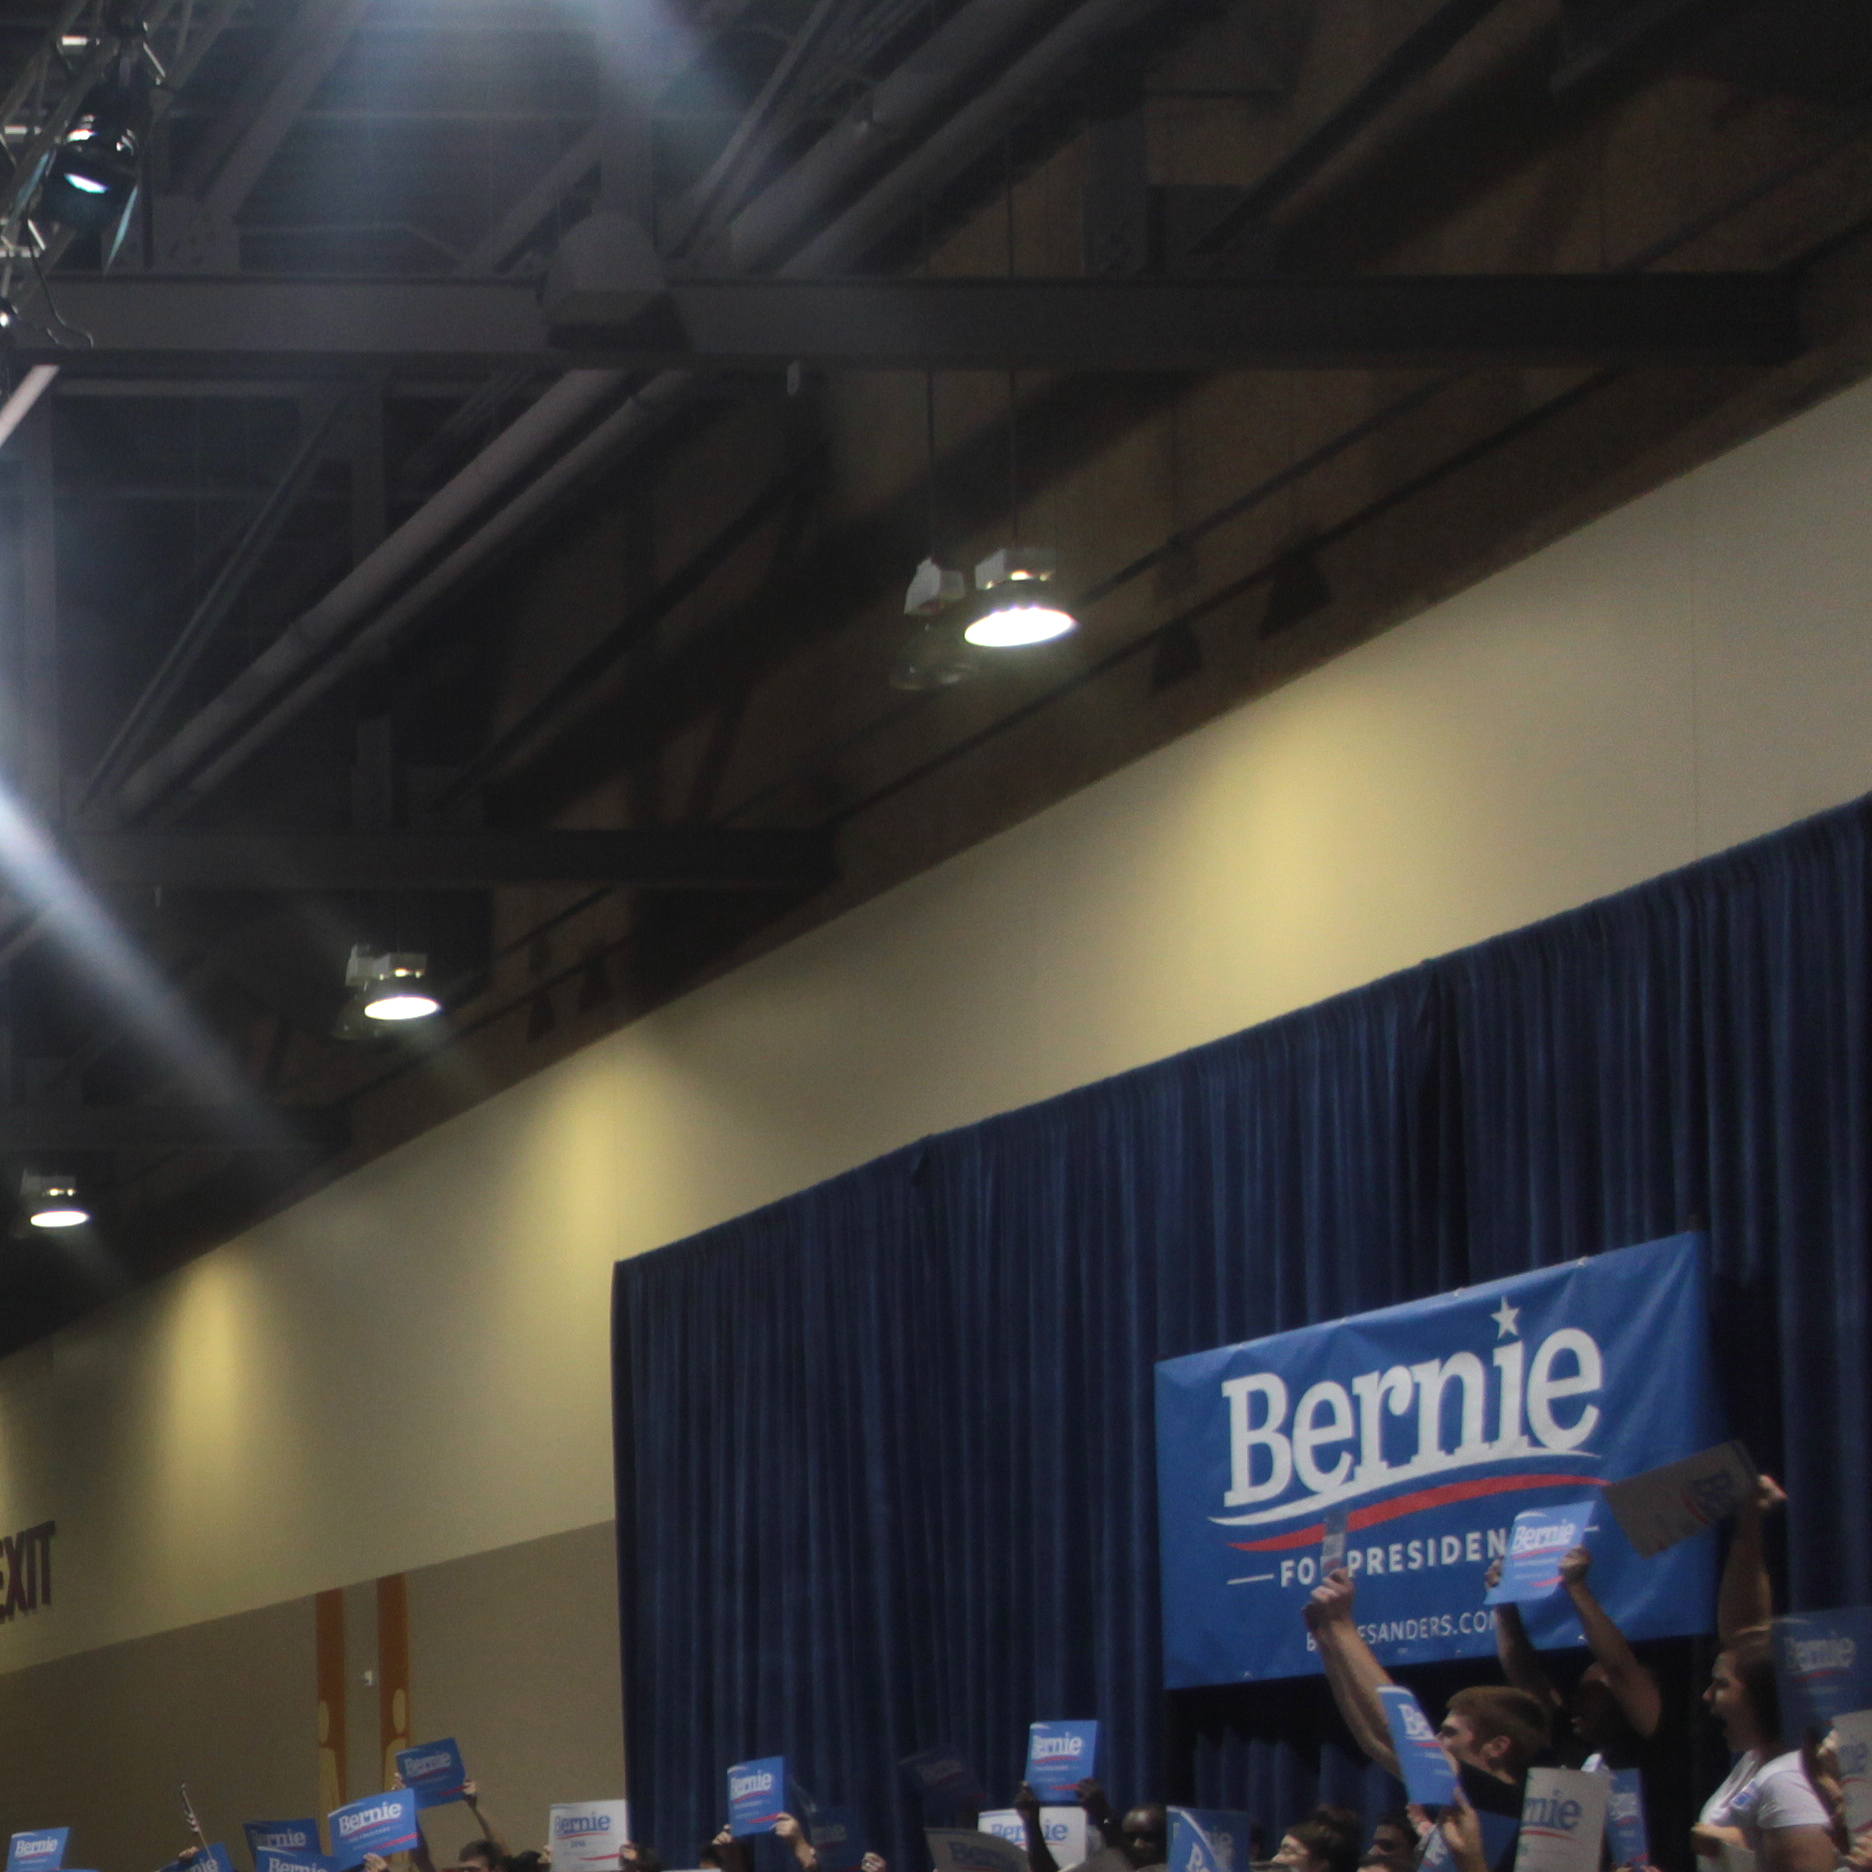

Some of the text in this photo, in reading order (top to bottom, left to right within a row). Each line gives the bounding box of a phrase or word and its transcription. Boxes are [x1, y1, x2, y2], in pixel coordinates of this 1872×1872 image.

[1221, 1297, 1603, 1507] Bernie
[1280, 1529, 1508, 1588] FO PRESIDEN
[339, 1801, 402, 1837] Bernie
[14, 1837, 59, 1858] Bernie
